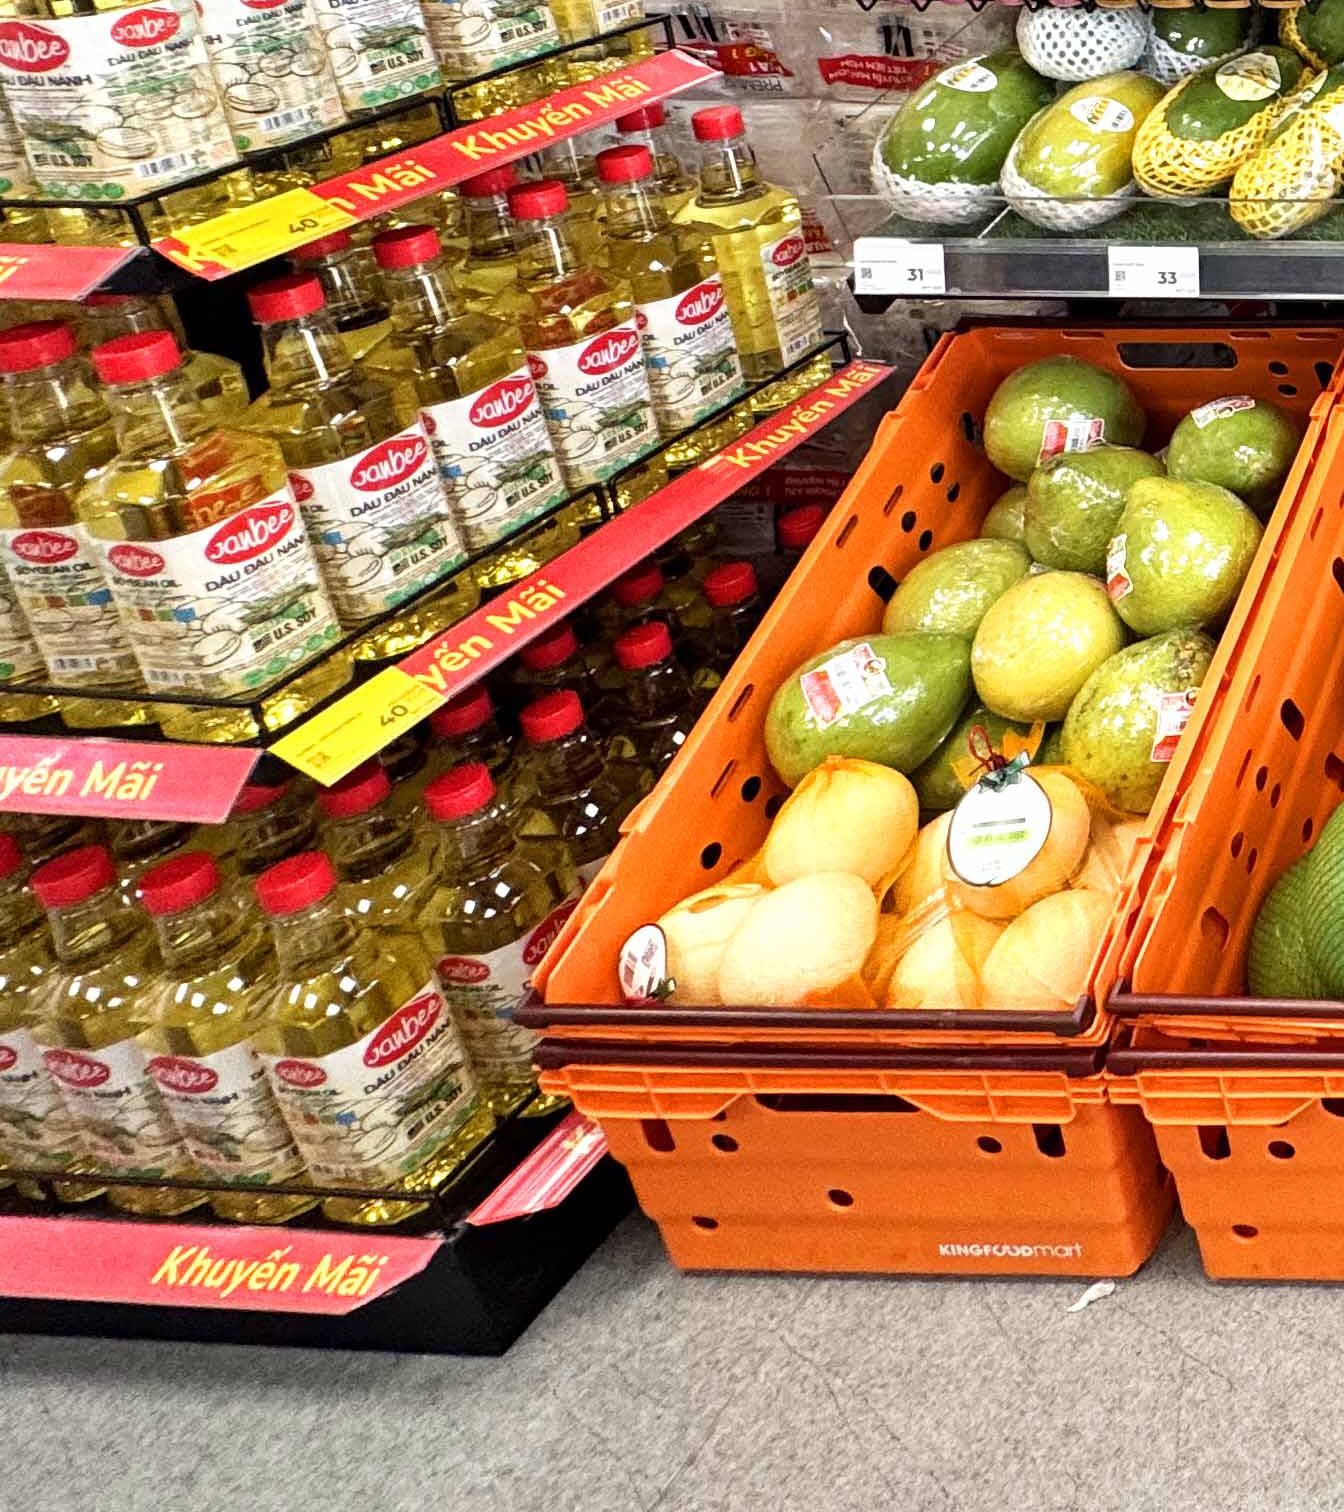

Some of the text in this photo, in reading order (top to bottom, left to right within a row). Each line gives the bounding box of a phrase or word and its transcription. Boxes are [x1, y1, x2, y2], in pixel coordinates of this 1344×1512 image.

[452, 73, 652, 164] Khuyến Mãi
[357, 160, 439, 210] Mãi
[906, 268, 925, 281] 31
[1157, 271, 1178, 284] 33
[727, 363, 887, 472] Khuyến Mãi
[487, 578, 567, 651] Mãi
[78, 759, 164, 806] Mãi
[150, 1245, 392, 1298] Khuyến Mãi
